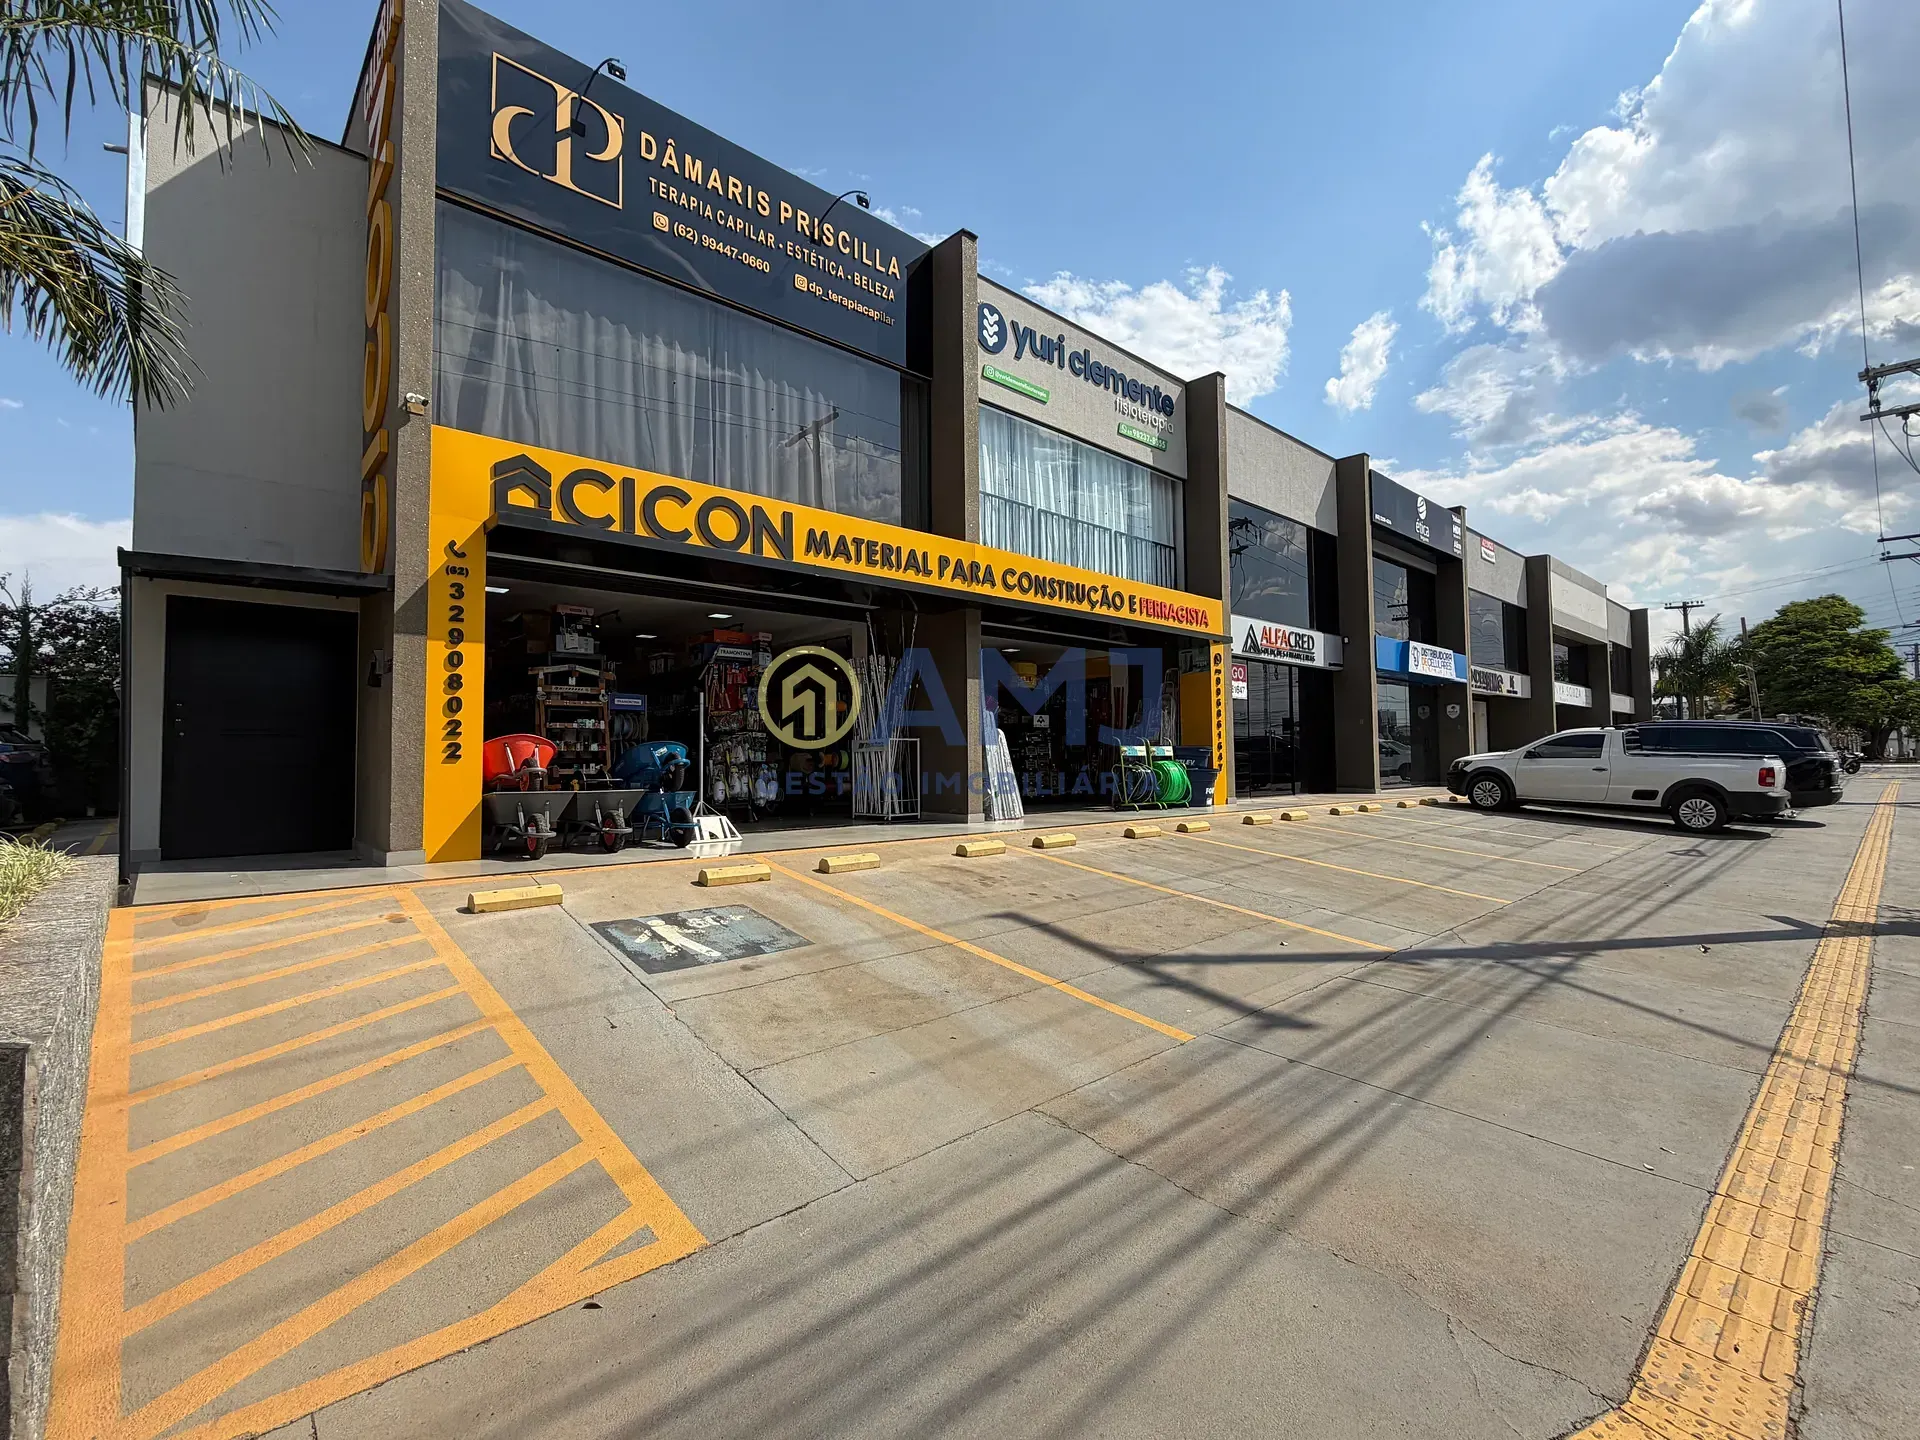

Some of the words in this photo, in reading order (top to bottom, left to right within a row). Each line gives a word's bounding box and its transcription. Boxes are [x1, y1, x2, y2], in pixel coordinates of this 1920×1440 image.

[639, 131, 771, 217] DÂMARIS
[780, 200, 901, 280] PRISCILLA
[649, 176, 713, 222] TERAPIA
[717, 211, 776, 250] CAPILAR
[787, 240, 845, 281] ESTÉTICA
[854, 271, 896, 302] BELEZA
[673, 221, 699, 246] (62)
[701, 234, 771, 273] 99447-0660
[809, 280, 896, 327] dp_terapiacapilar
[1011, 320, 1066, 370] yuri
[1069, 348, 1175, 417] clemente
[1115, 396, 1174, 434] fisioterapia
[445, 565, 469, 578] (62)
[556, 467, 794, 561] CICON
[805, 528, 932, 577] MATERIAL
[938, 555, 997, 588] PARA
[1001, 568, 1126, 611] CONSTRUÇÃO
[1128, 595, 1137, 614] E
[1139, 598, 1210, 628] FERRAGISTA
[1260, 625, 1315, 651] ALFACRED
